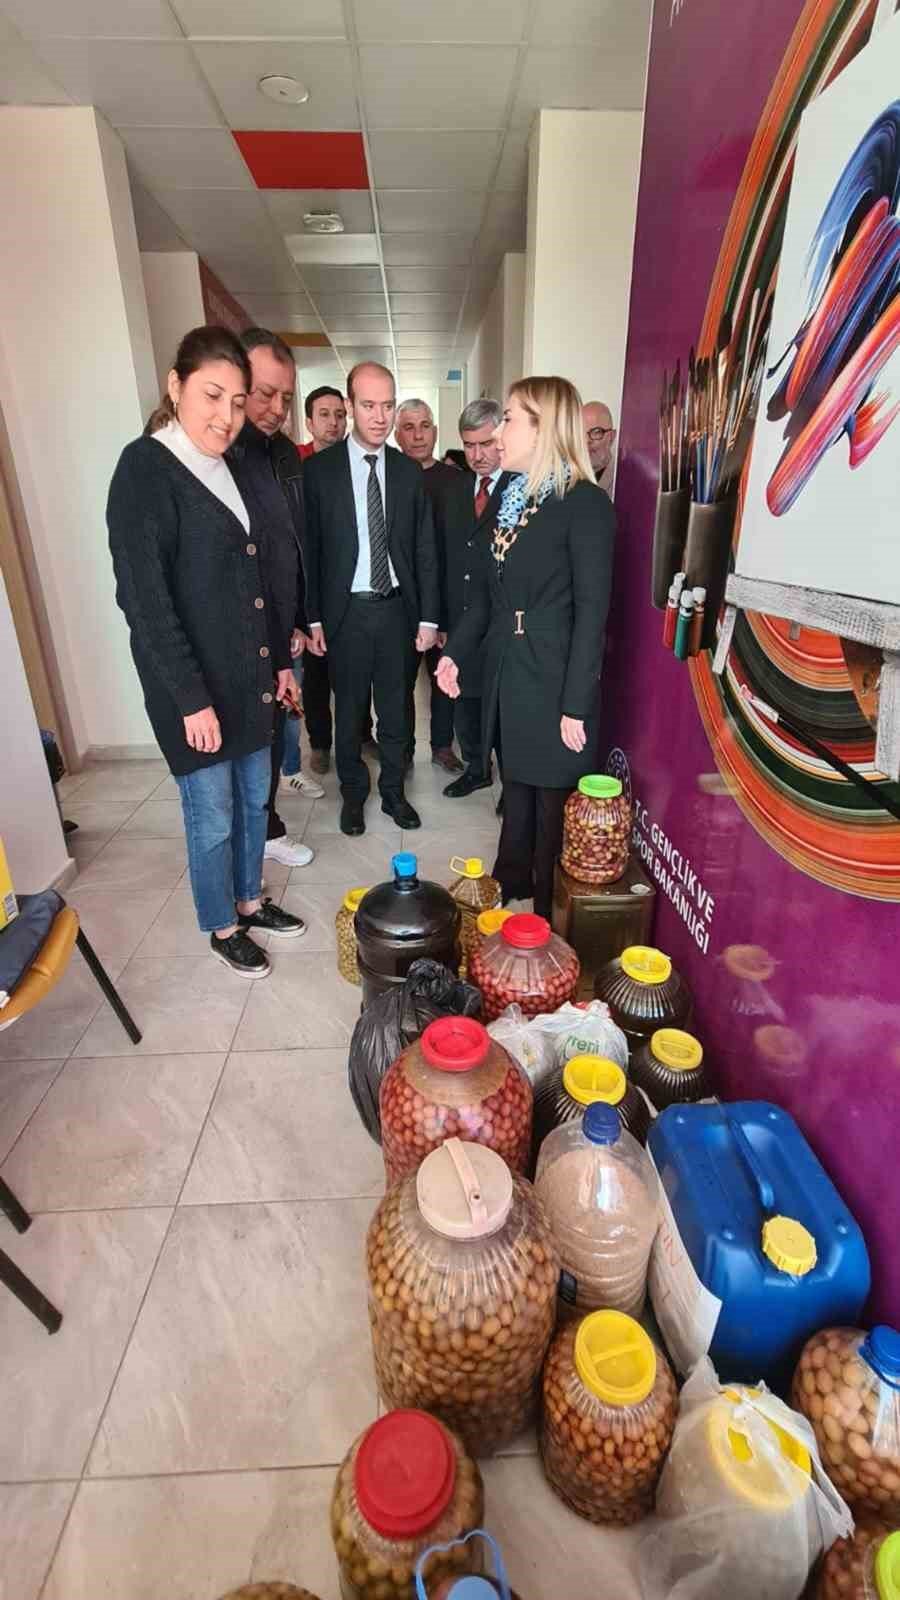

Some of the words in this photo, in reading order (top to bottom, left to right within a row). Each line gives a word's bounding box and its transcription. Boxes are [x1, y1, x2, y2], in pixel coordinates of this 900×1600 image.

[631, 826, 653, 870] SPOR
[653, 858, 710, 955] BAKANLIĞI
[635, 799, 649, 832] T.C.
[651, 823, 696, 897] GENÇLİK
[698, 883, 715, 923] VE
